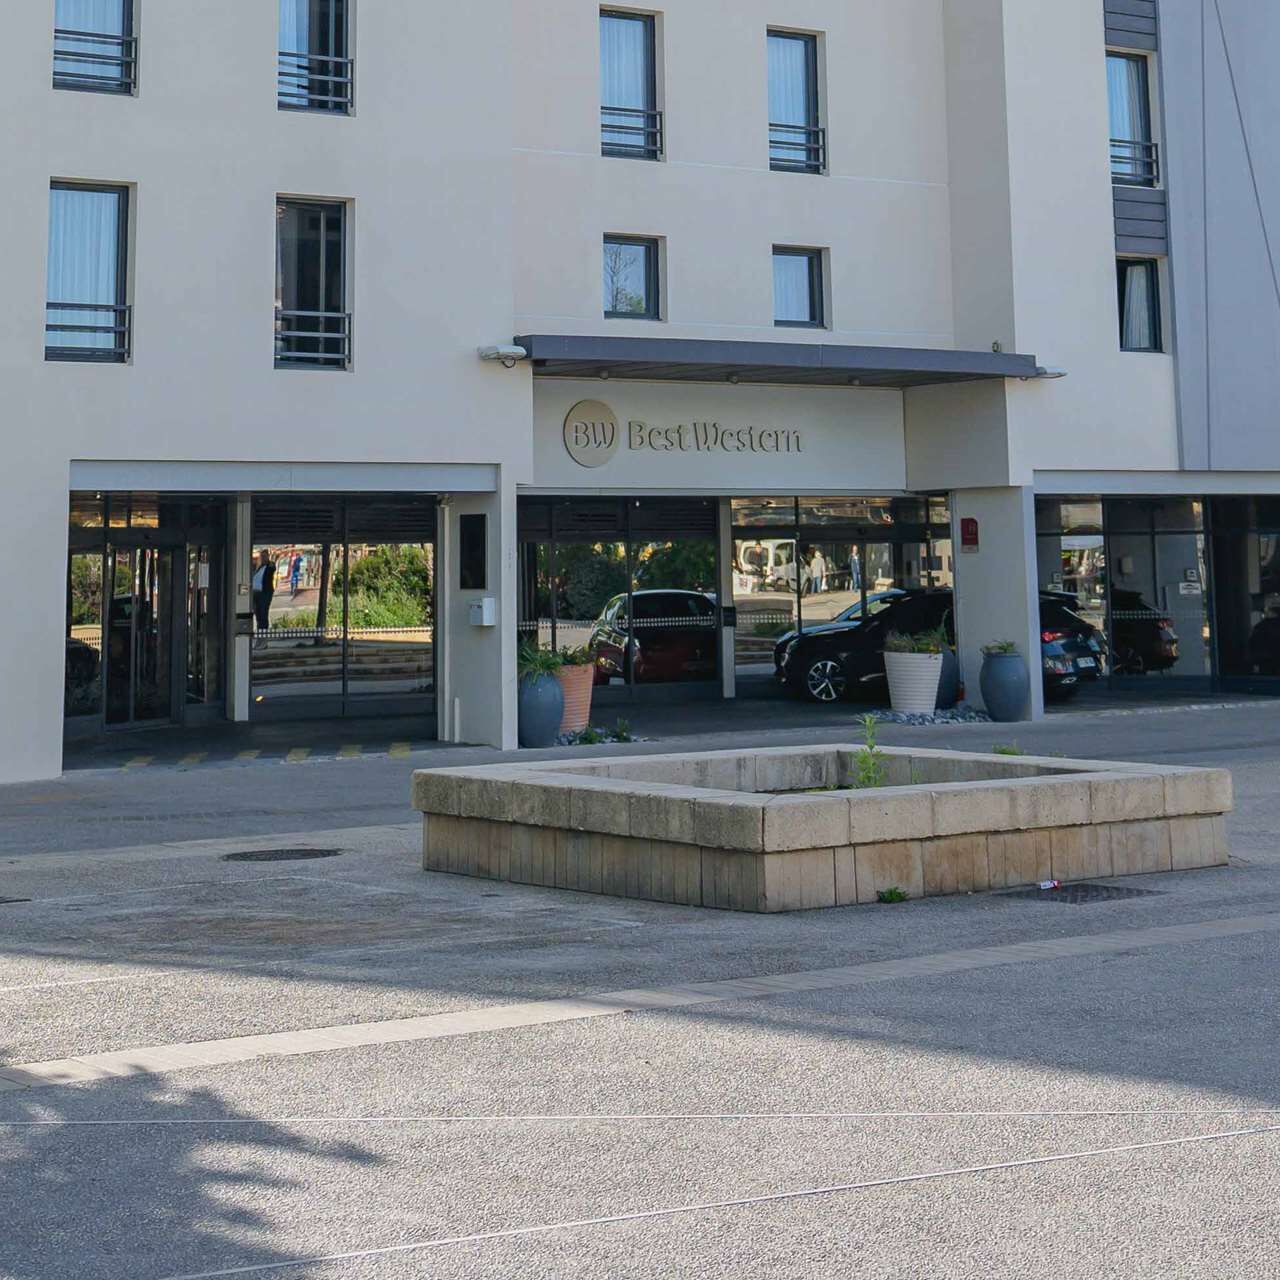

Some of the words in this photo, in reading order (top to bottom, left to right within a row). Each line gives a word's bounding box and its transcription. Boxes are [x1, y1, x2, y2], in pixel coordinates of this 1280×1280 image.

[573, 420, 616, 449] BW
[627, 420, 688, 451] Best
[692, 421, 804, 453] Western
